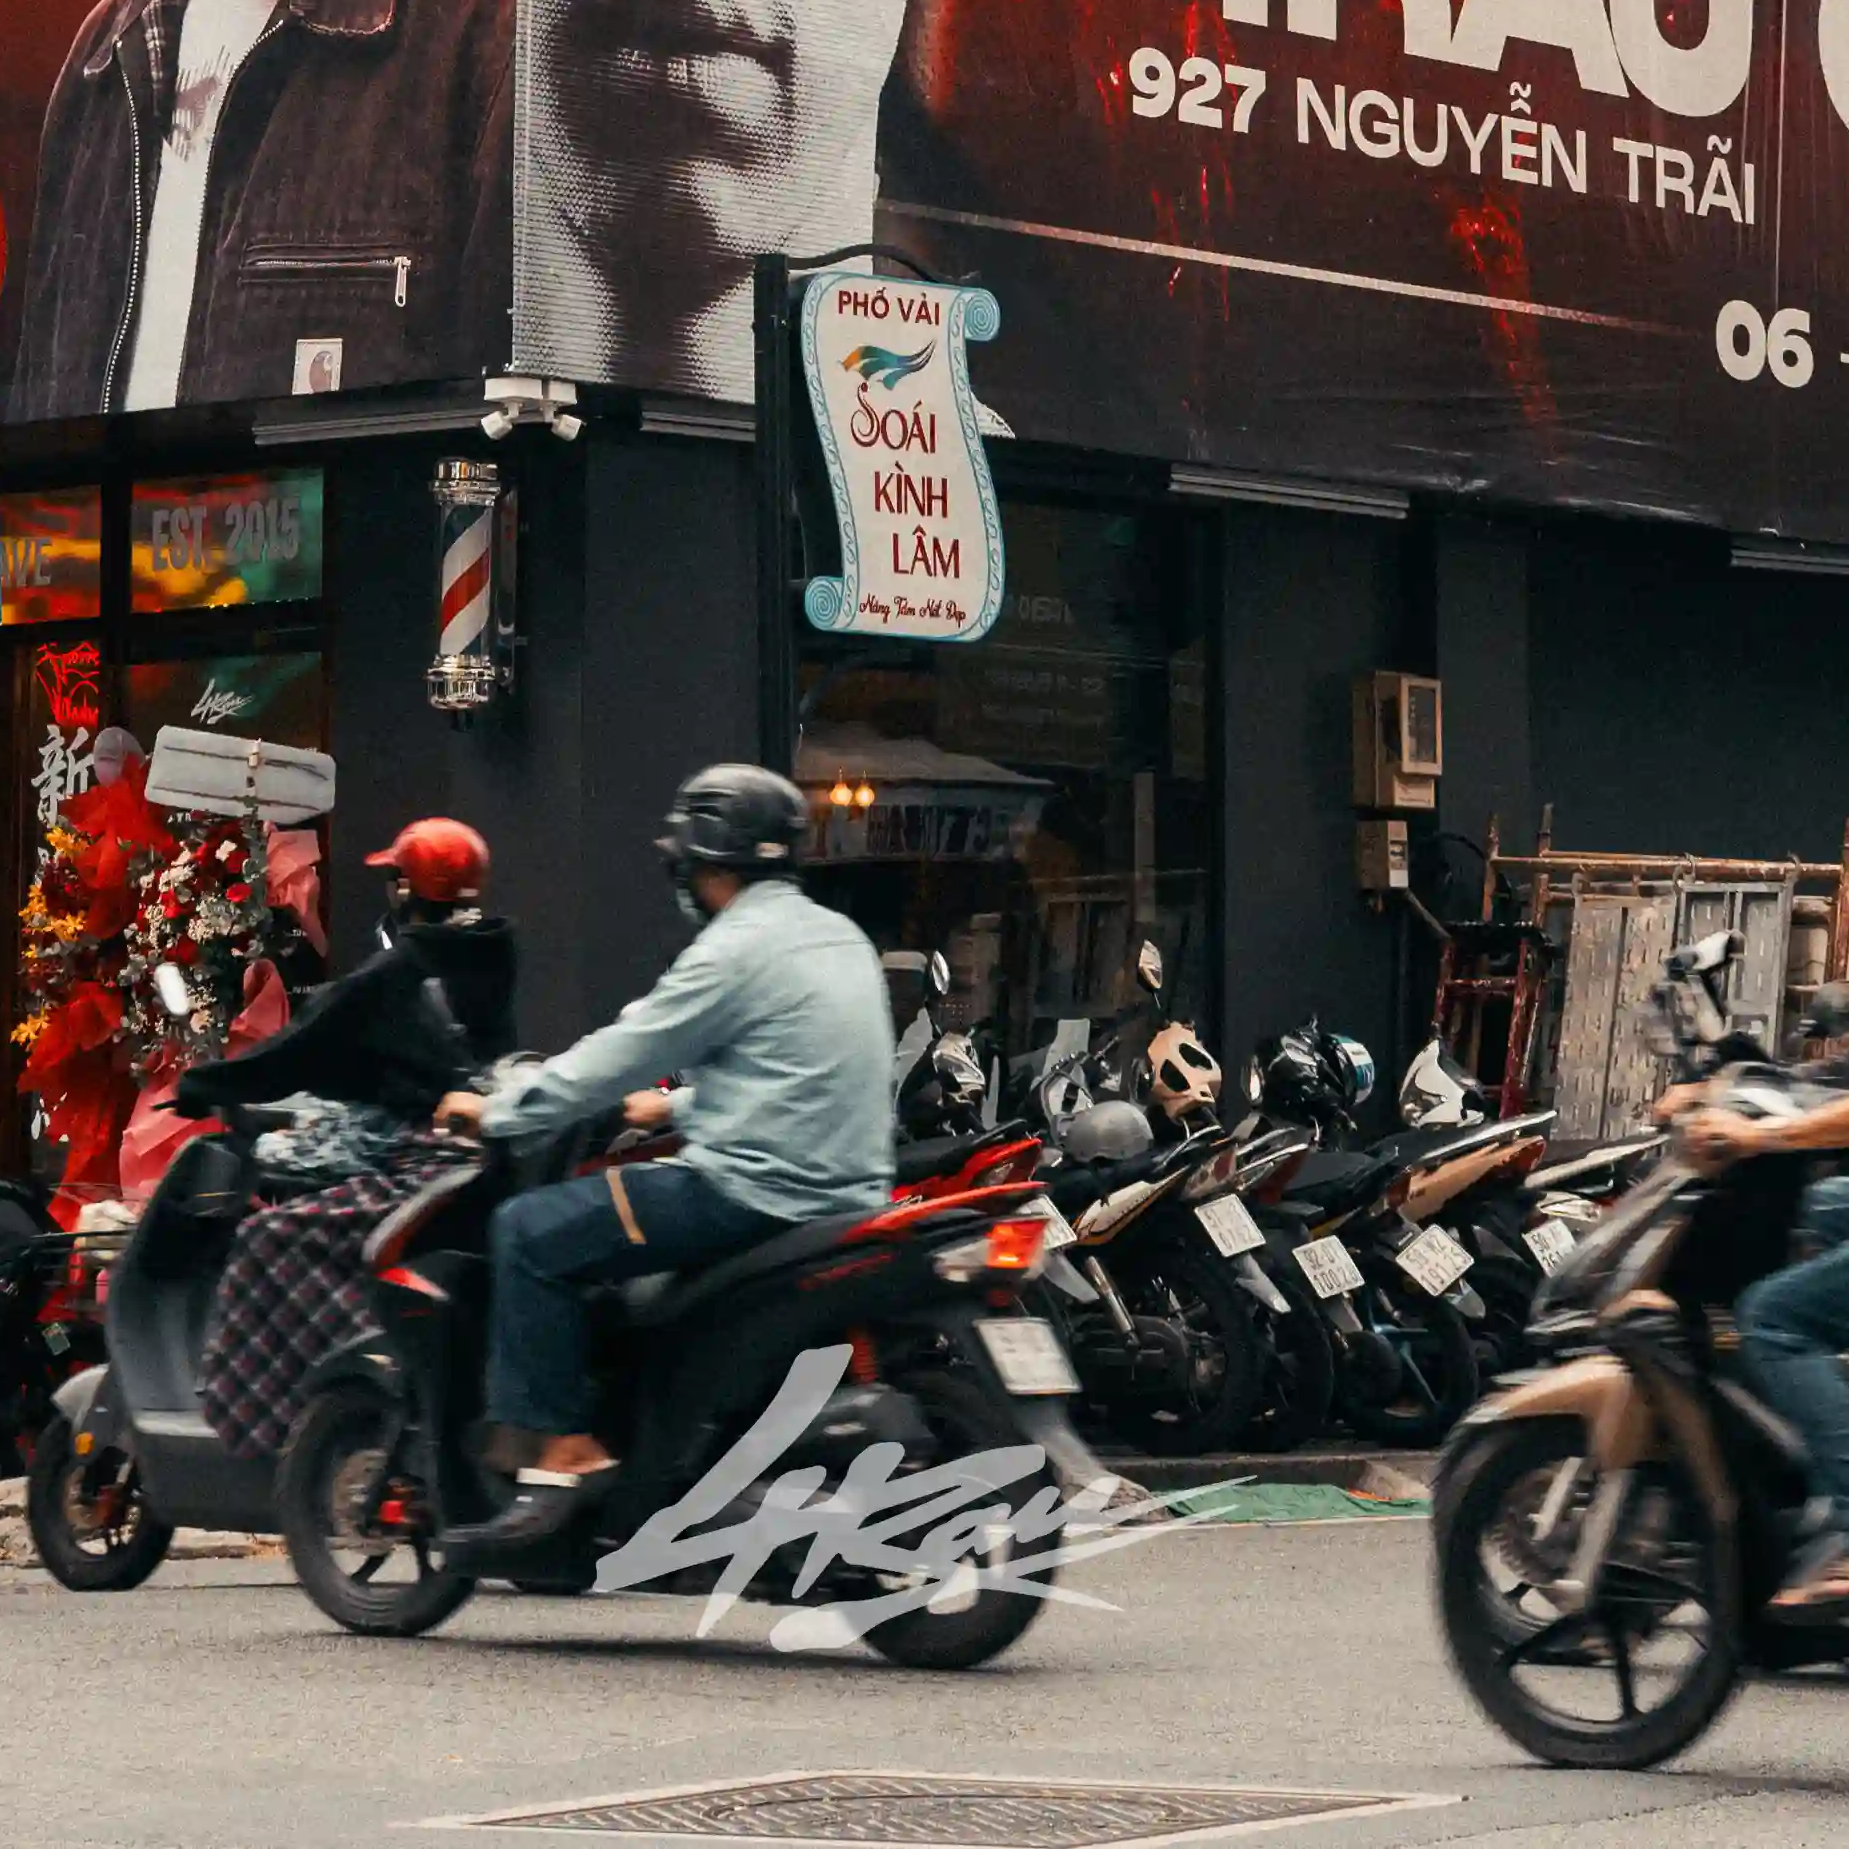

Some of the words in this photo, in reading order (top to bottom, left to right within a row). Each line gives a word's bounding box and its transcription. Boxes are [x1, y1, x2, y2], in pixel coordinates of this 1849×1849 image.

[1128, 47, 1267, 134] 927
[1296, 81, 1588, 194] NGUYỄN
[1612, 134, 1756, 225] TRÃI
[837, 287, 890, 320] PHỐ
[897, 292, 940, 328] VẢI
[1715, 299, 1814, 389] 06
[873, 463, 949, 520] KÌNH
[225, 495, 302, 564] 2015
[892, 524, 960, 579] LÂM
